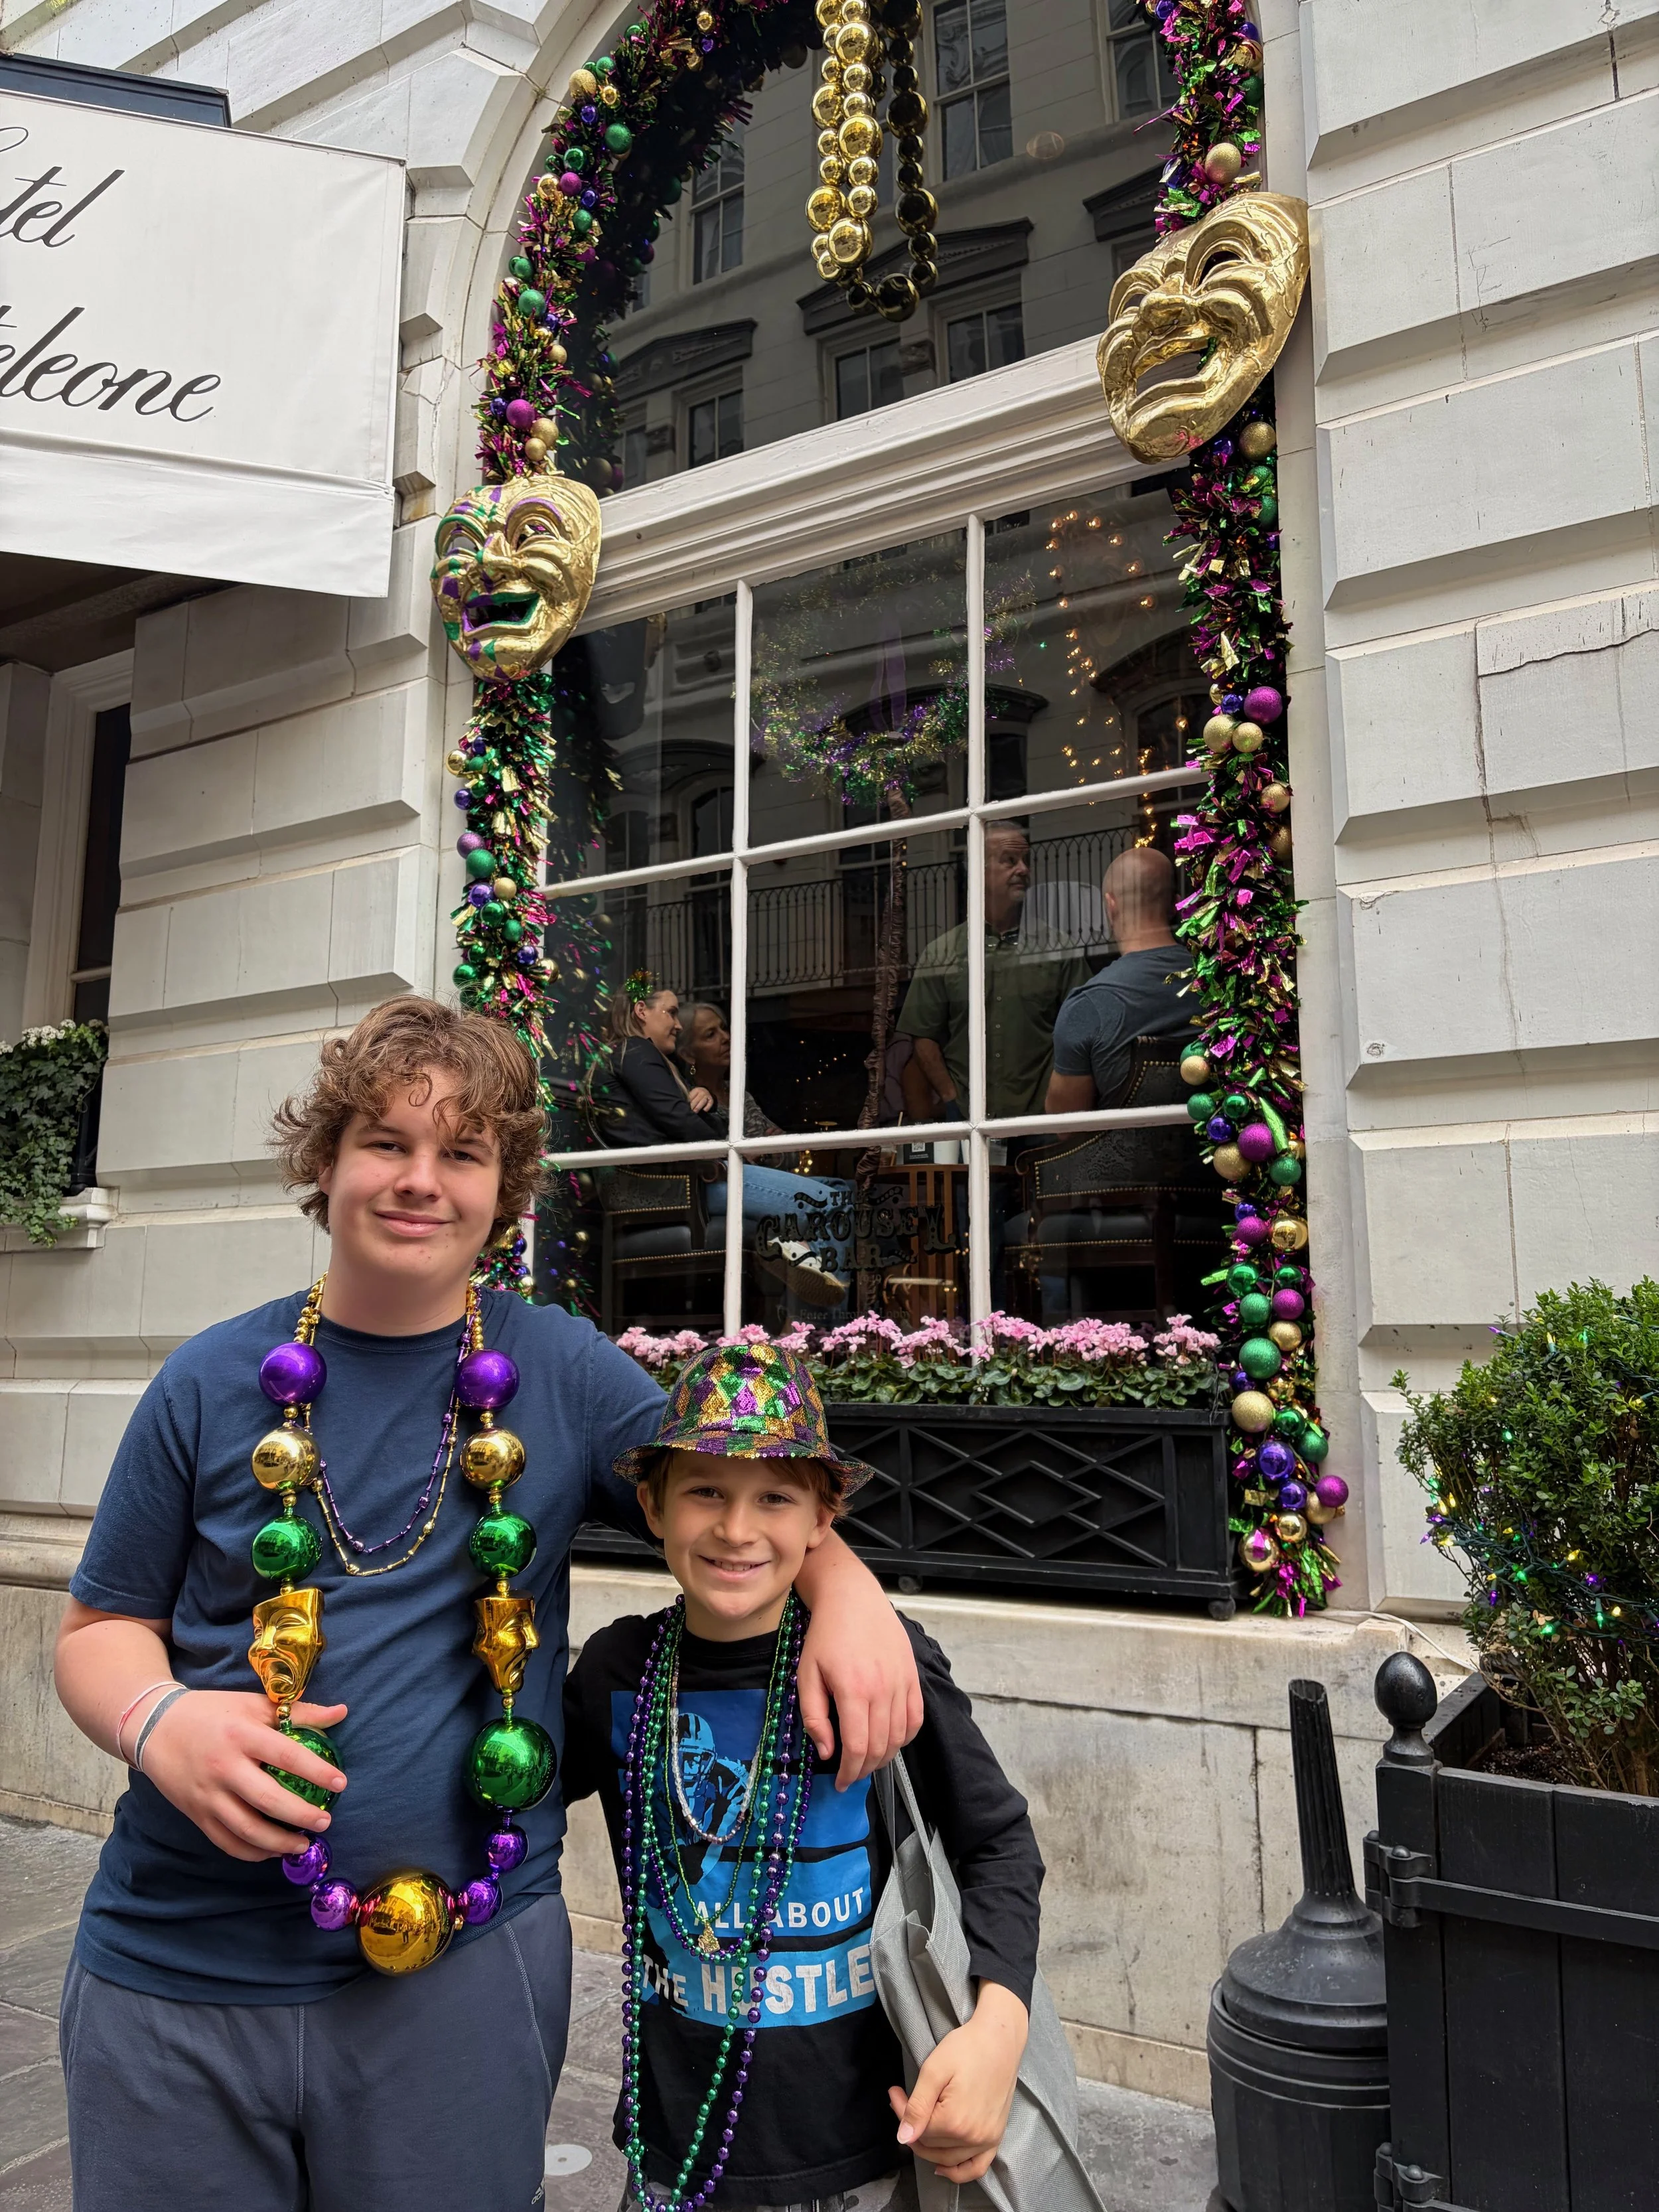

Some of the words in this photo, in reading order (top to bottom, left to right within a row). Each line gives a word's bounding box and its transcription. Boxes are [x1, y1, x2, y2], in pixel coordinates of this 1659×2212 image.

[0, 126, 125, 248] tel
[755, 1205, 956, 1260] CAROUSEL
[820, 1244, 882, 1273] BAR
[694, 1901, 746, 1929] ALL
[767, 1887, 863, 1928] ABOUT
[642, 1953, 689, 2007] THE
[701, 1943, 875, 2016] HUSTLE
